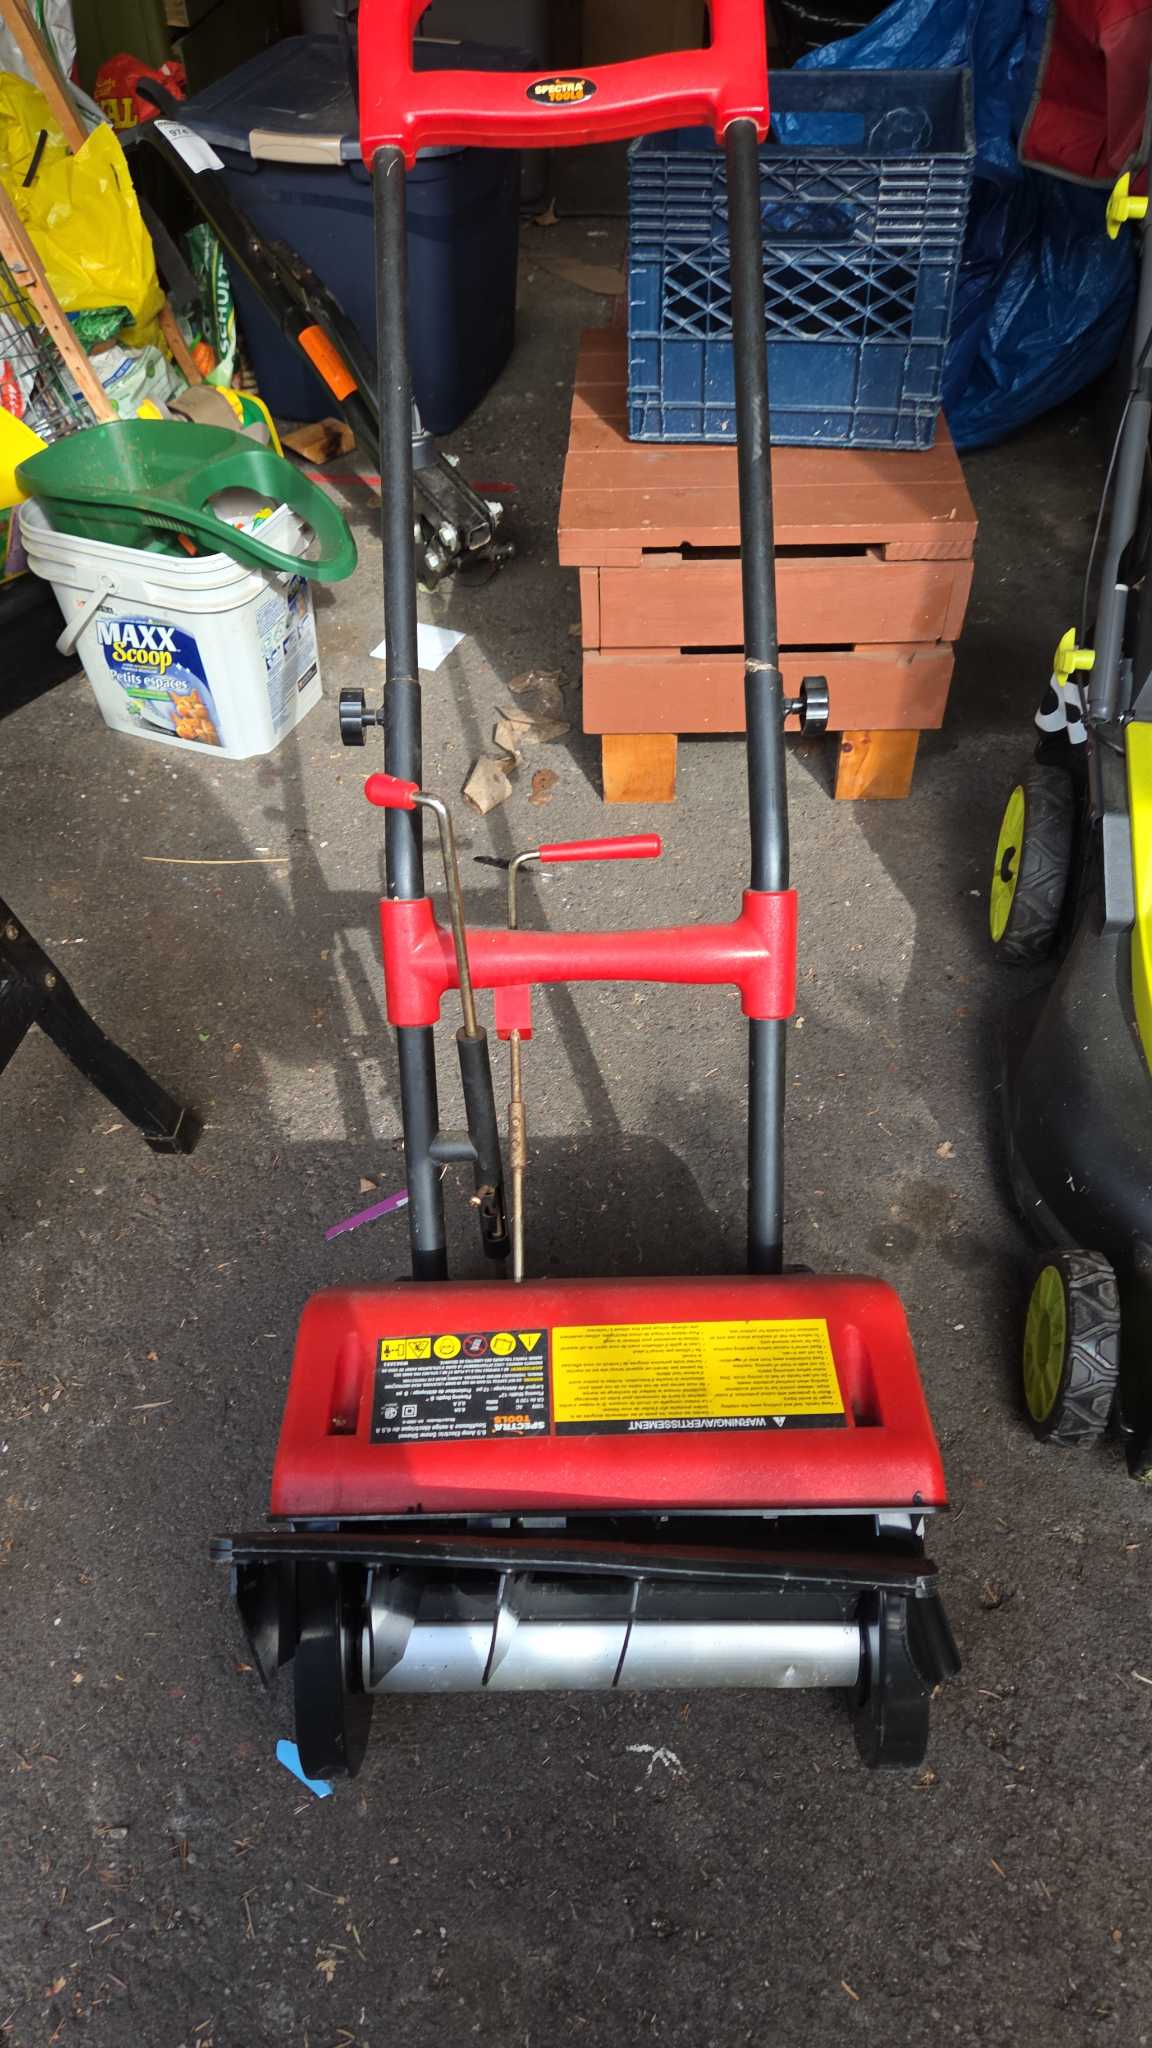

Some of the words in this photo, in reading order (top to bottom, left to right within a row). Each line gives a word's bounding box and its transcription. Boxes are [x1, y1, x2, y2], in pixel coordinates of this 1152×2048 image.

[535, 82, 583, 94] SPECTRA
[549, 90, 584, 101] TOOLS
[217, 254, 230, 353] SCHULT
[96, 620, 177, 652] MAXX
[112, 641, 172, 675] Scoop
[110, 670, 142, 684] Petits
[143, 675, 188, 690] espaces
[494, 1414, 529, 1424] TOOLS
[629, 1418, 766, 1430] WARNING/AVERTISSEMENT
[494, 1422, 545, 1431] SPECTRA
